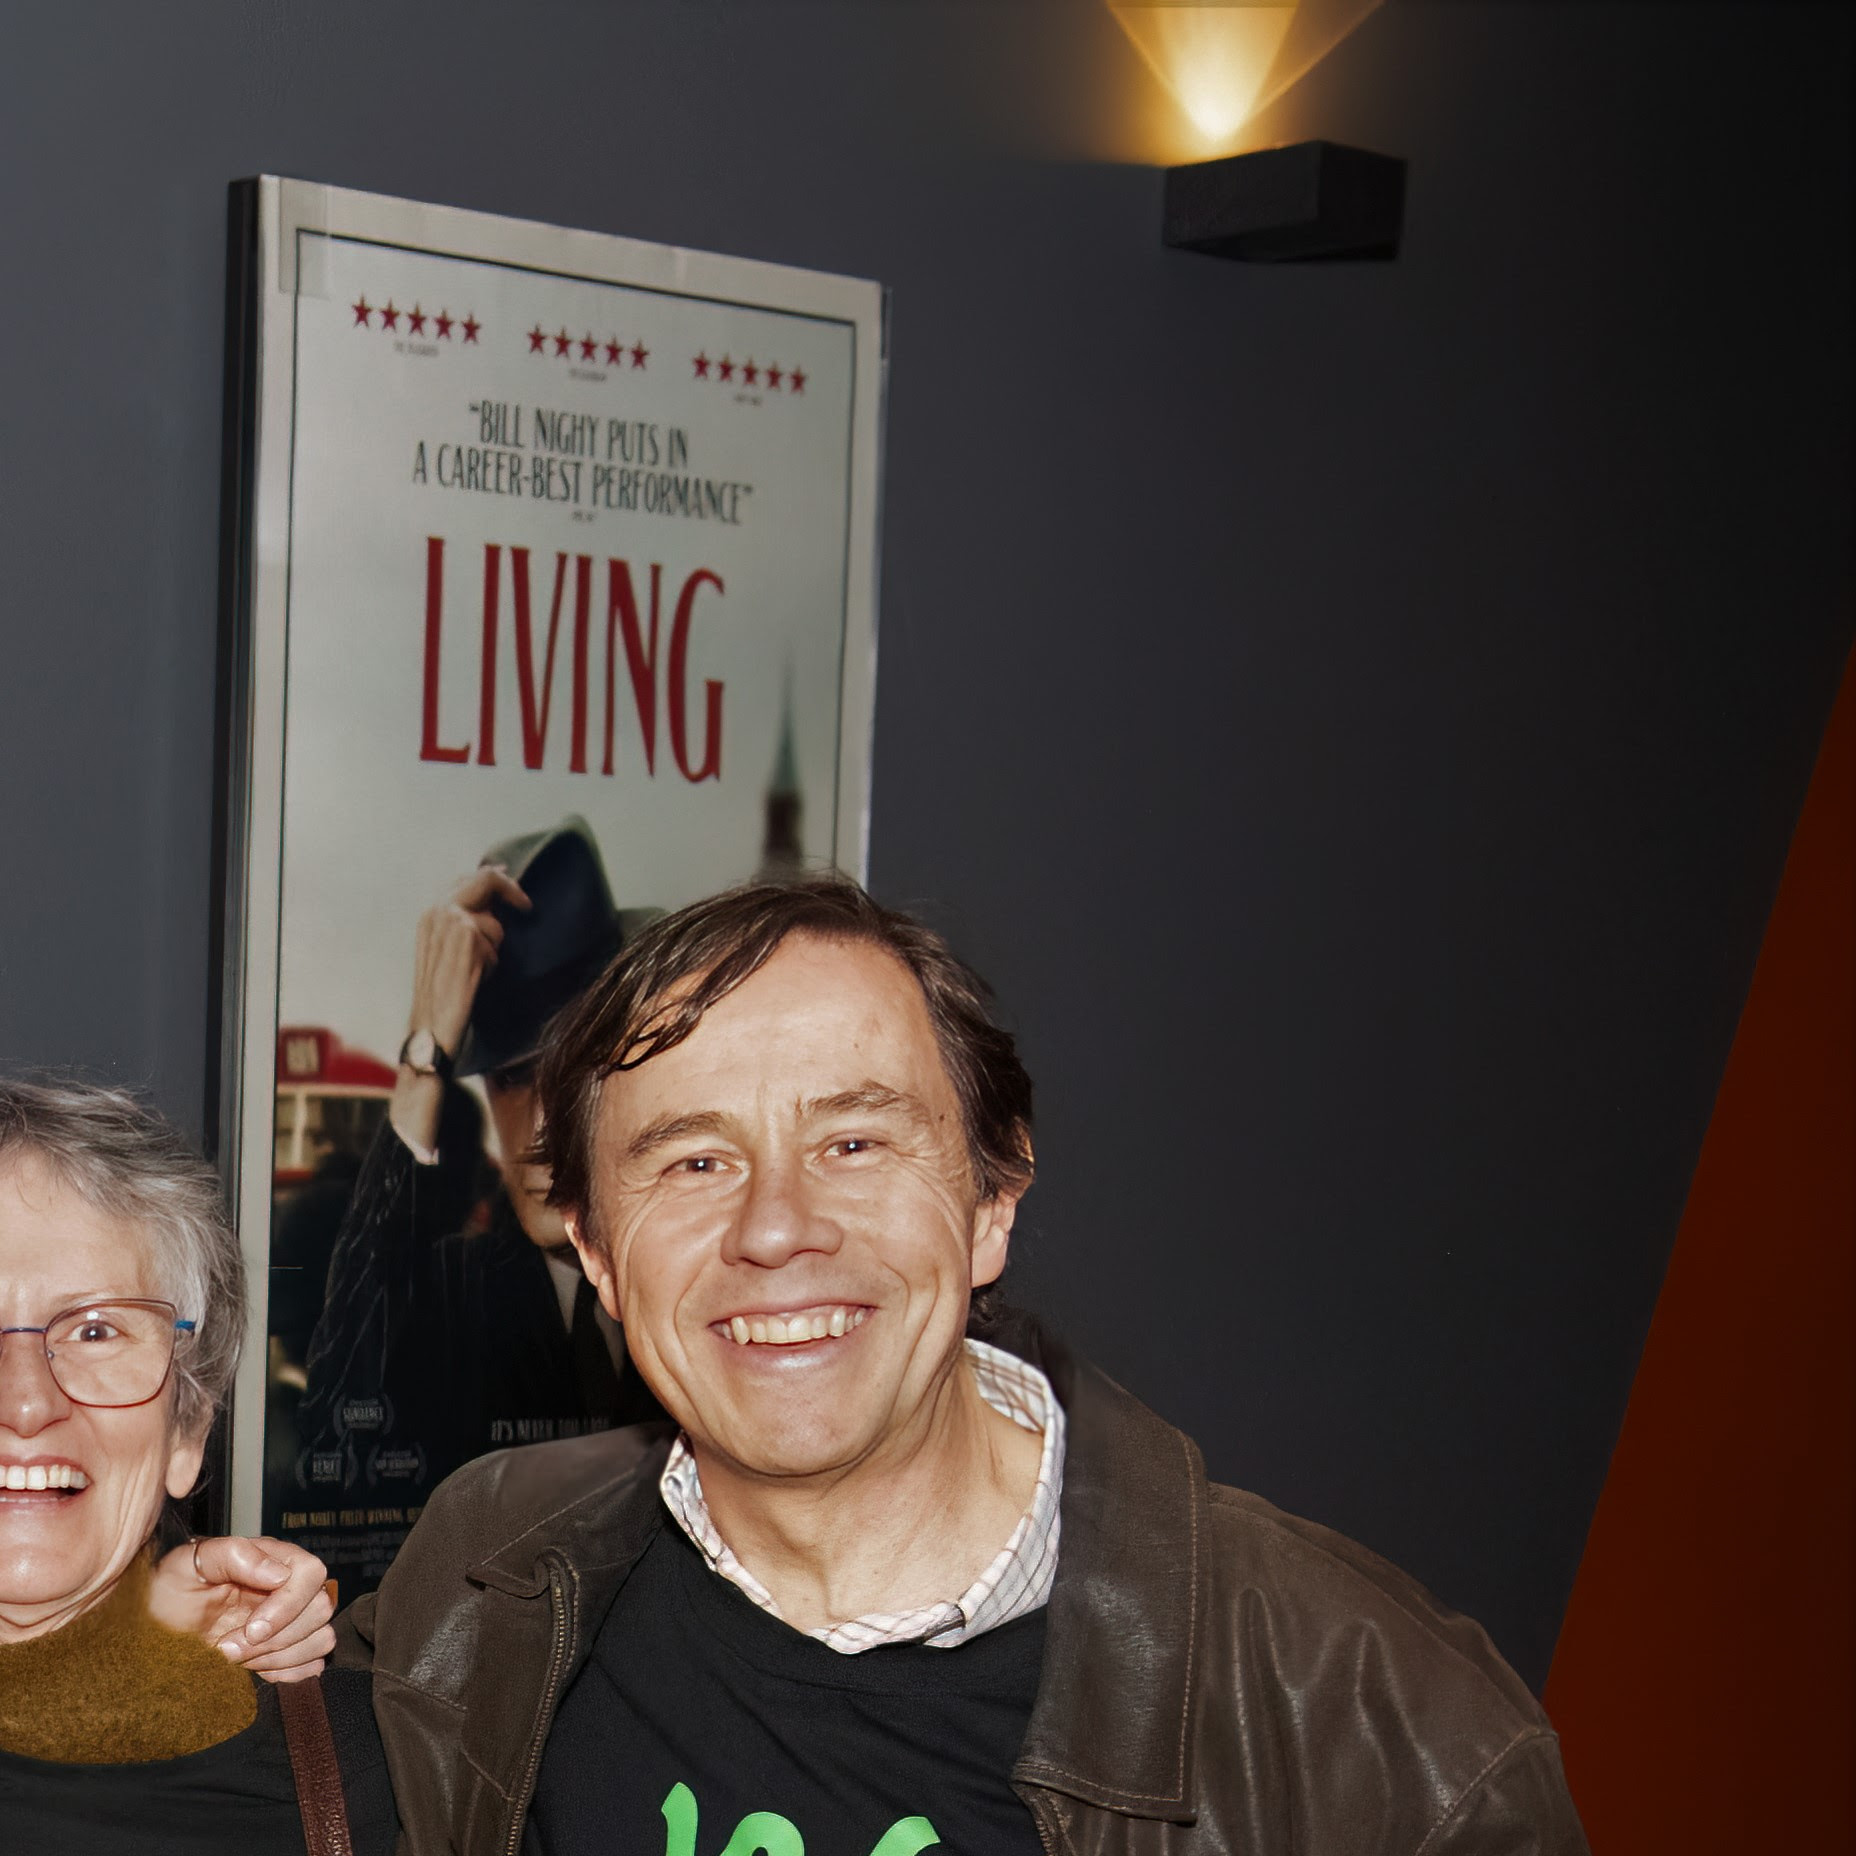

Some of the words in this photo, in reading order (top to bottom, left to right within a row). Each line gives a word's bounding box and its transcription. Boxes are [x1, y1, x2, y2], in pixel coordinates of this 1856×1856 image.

[534, 408, 599, 459] NIGHY
[607, 418, 661, 467] PUTS
[668, 427, 689, 469] IN
[413, 440, 428, 484] A
[436, 443, 583, 504] CAREER-BEST
[418, 536, 726, 784] LIVING
